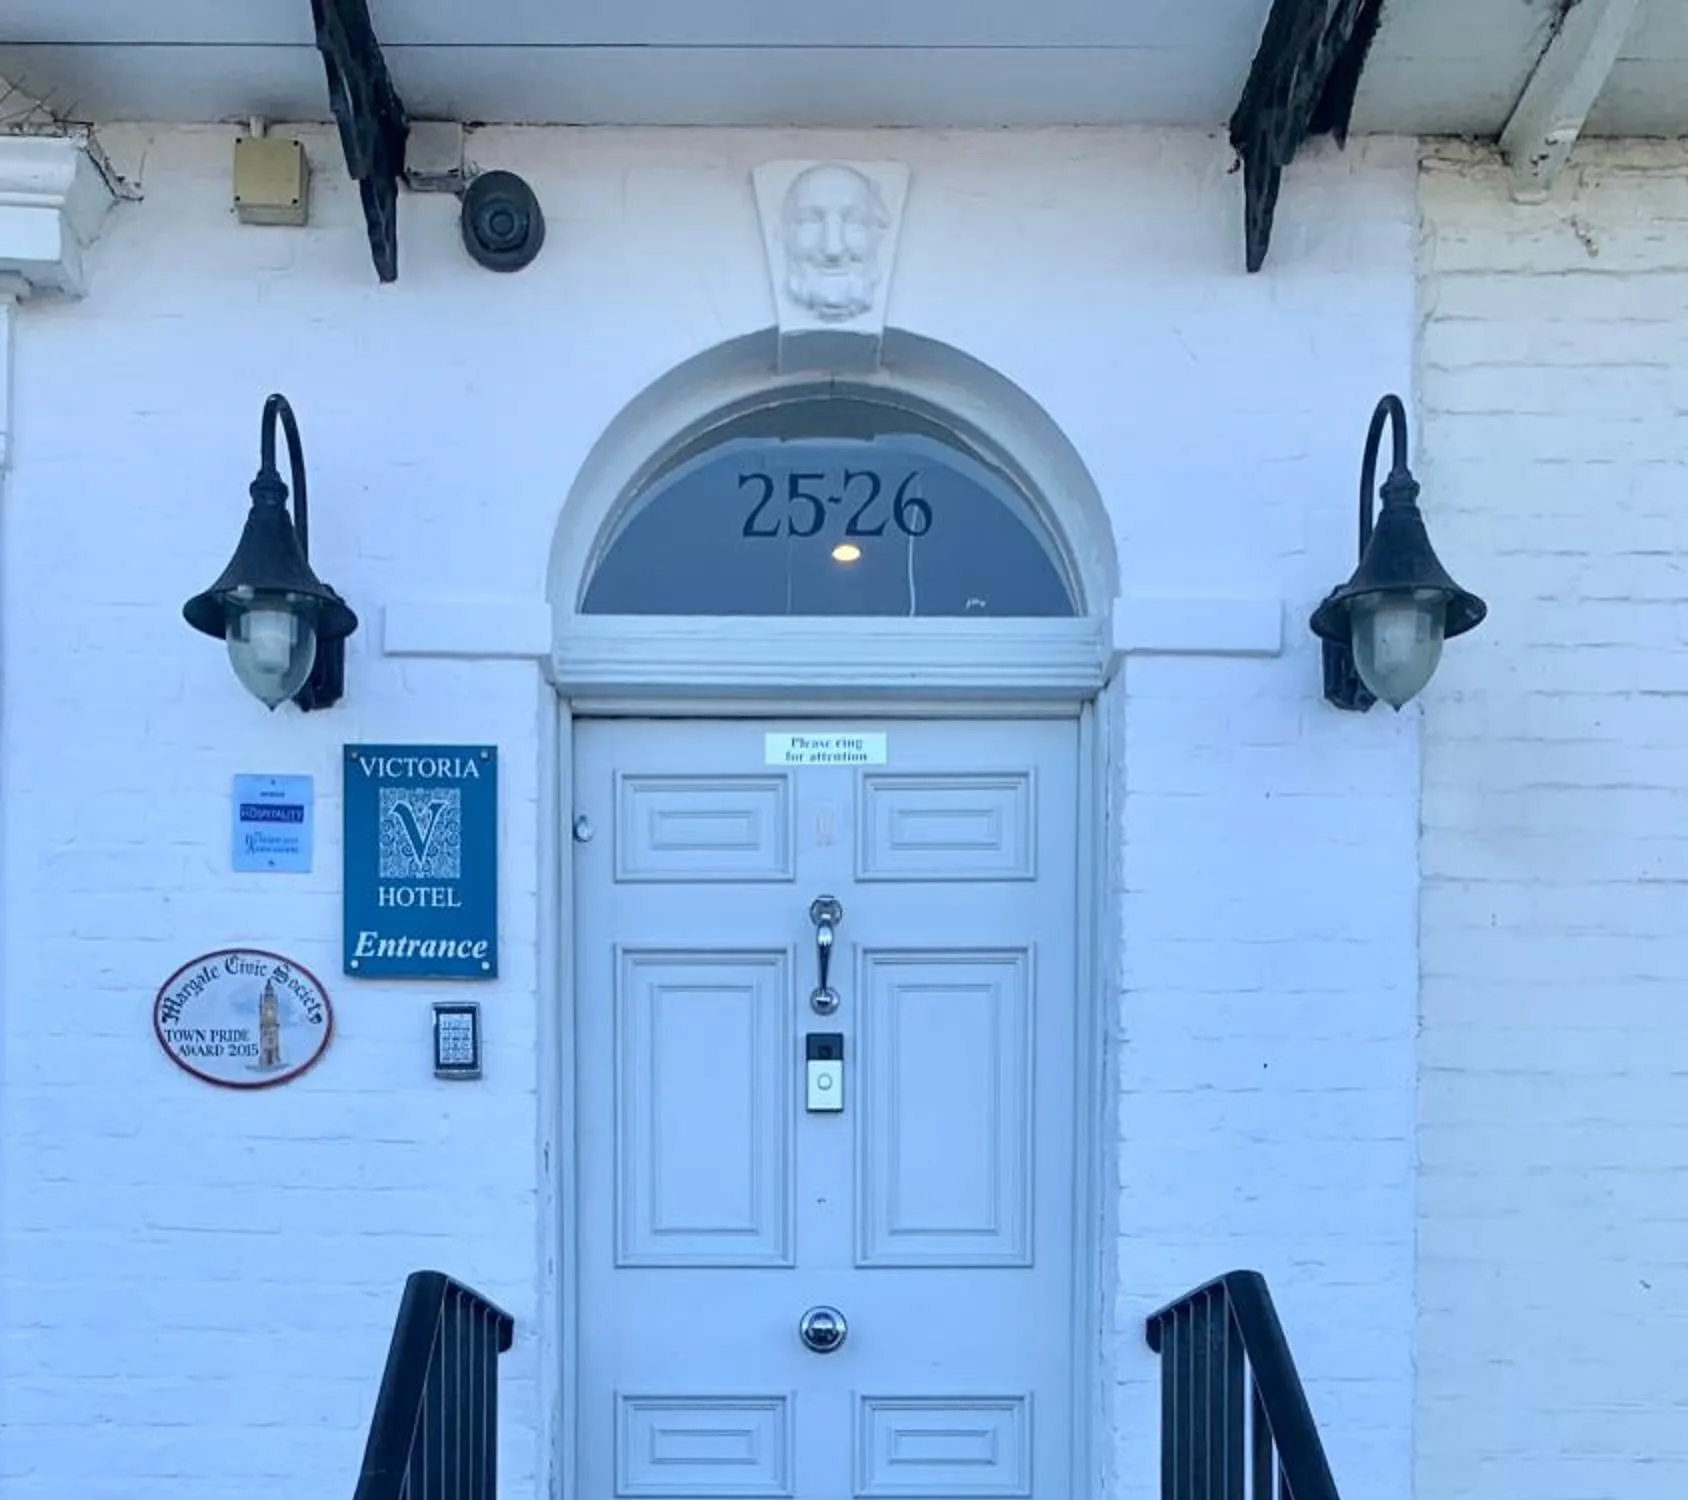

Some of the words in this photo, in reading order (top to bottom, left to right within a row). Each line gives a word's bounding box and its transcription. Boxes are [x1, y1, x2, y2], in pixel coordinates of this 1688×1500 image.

[737, 469, 933, 538] 25-26
[791, 737, 831, 749] Please
[835, 737, 863, 750] ring
[359, 756, 480, 779] VICTORIA
[785, 751, 803, 761] for
[809, 751, 867, 762] attention
[388, 799, 450, 867] V
[378, 886, 462, 908] HOTEL
[353, 930, 489, 959] Entrance
[161, 964, 221, 1026] Margate
[224, 953, 268, 977] Civic
[271, 963, 324, 1025] Society
[164, 1028, 207, 1043] TOWN
[210, 1028, 250, 1043] PRIDE
[178, 1043, 225, 1058] AWARD
[227, 1043, 260, 1058] 2015
